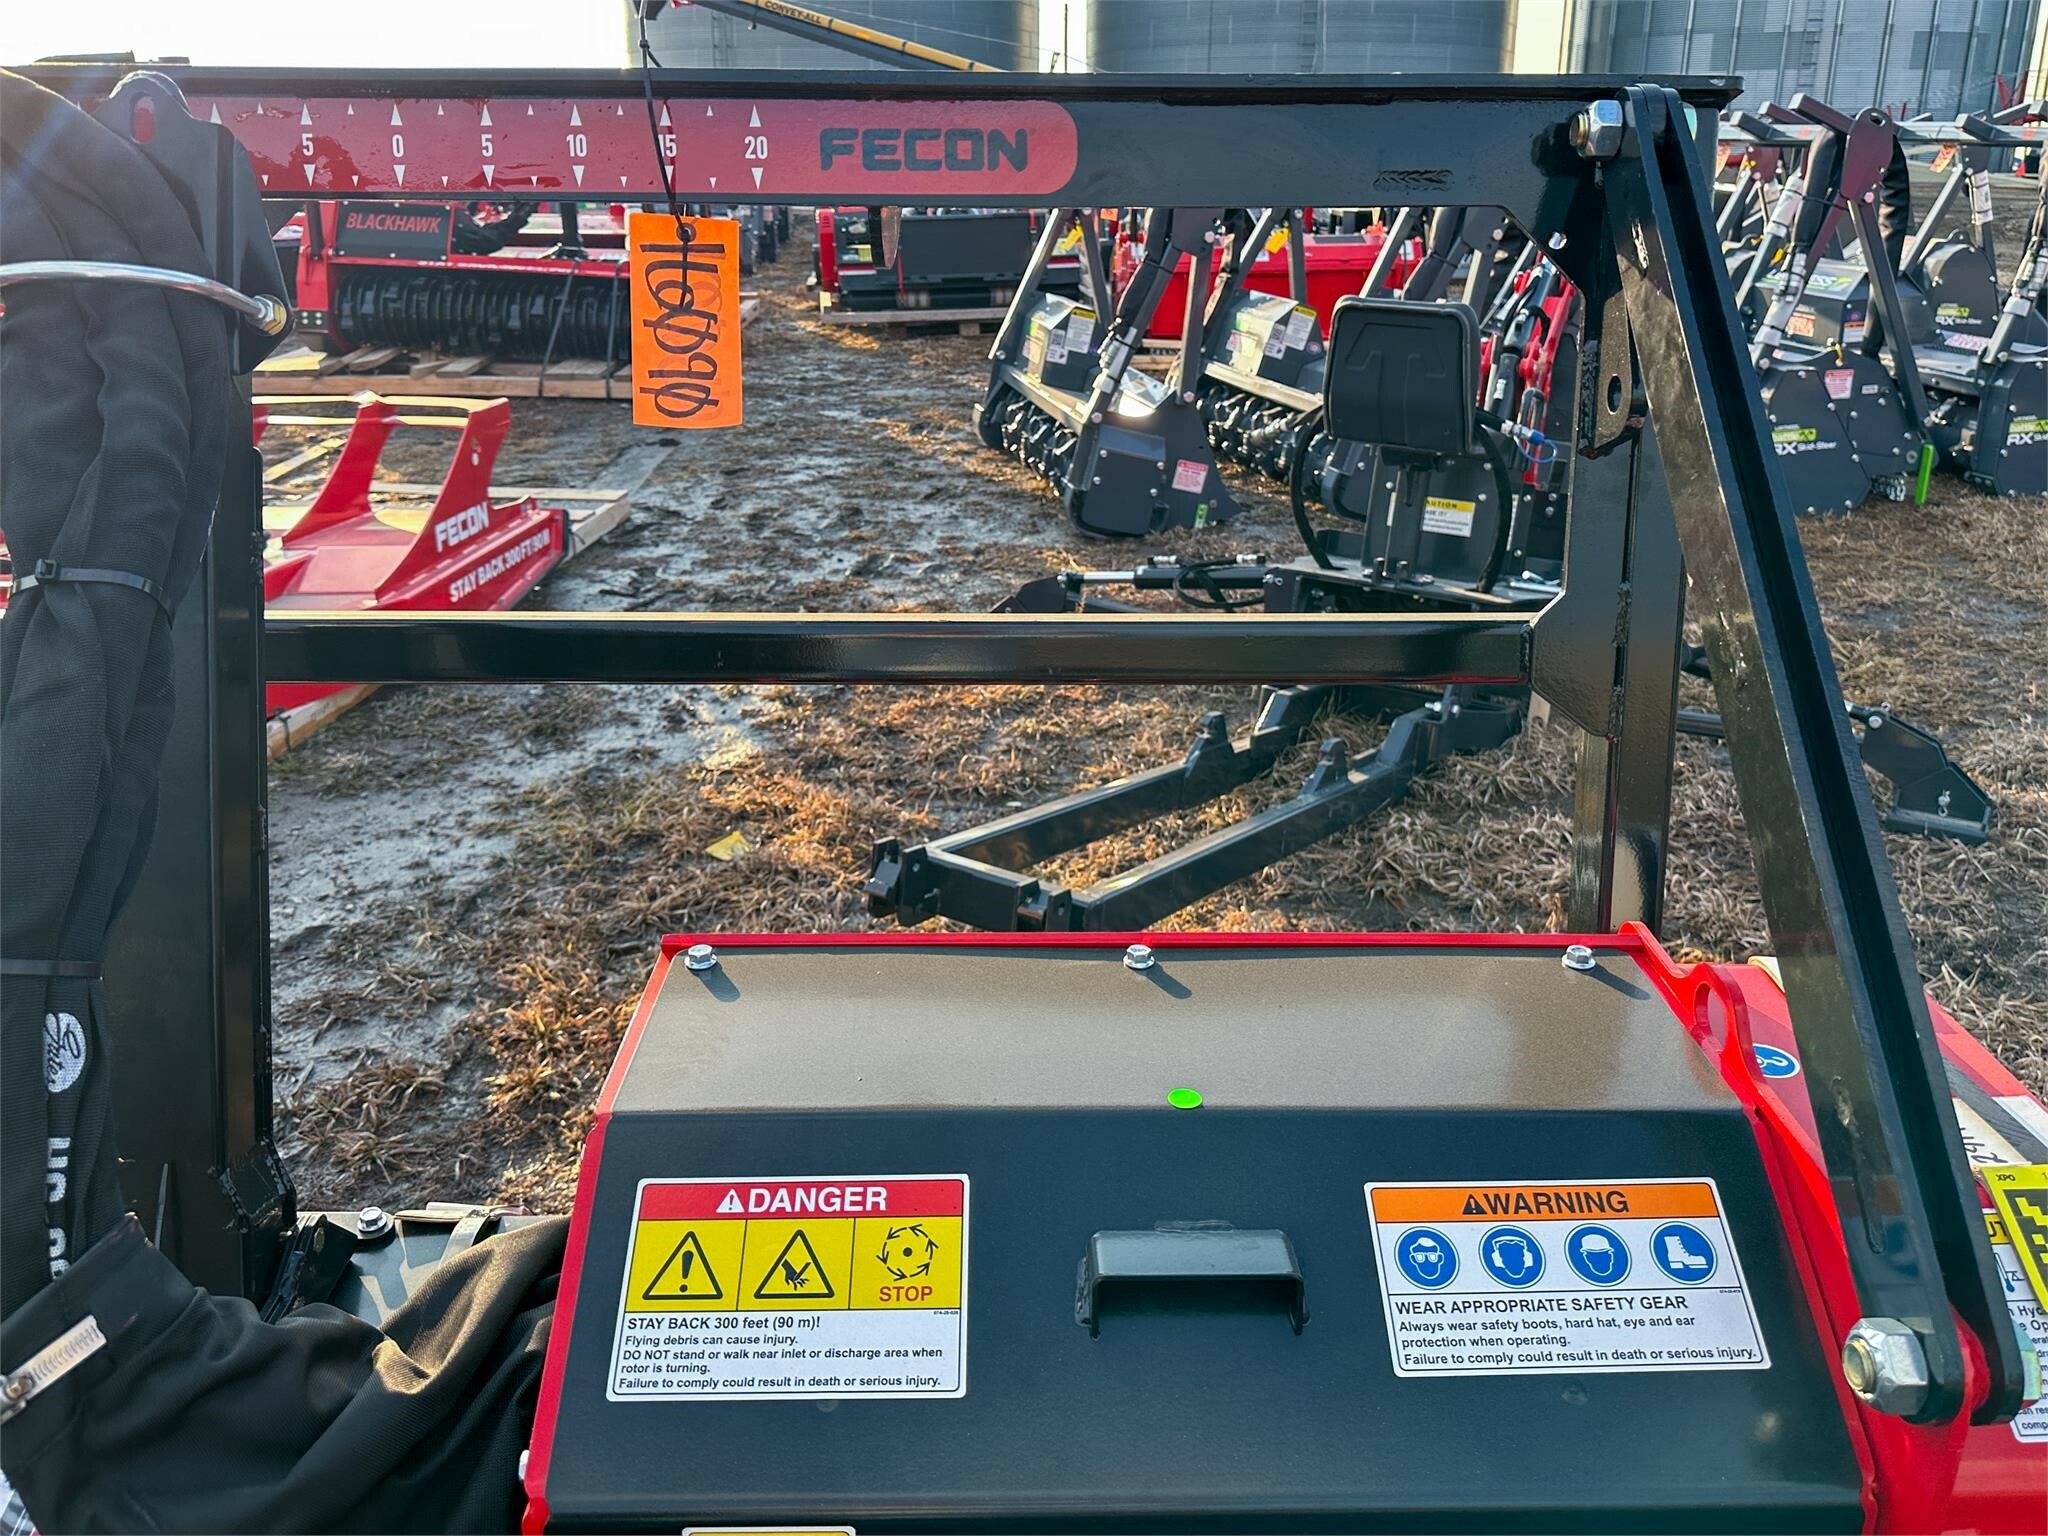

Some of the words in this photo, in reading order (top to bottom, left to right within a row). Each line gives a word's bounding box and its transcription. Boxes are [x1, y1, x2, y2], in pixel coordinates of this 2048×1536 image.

[301, 133, 314, 157] 5
[391, 134, 404, 158] 0
[482, 133, 494, 157] 5
[565, 134, 587, 158] 10
[658, 134, 677, 158] 15
[744, 135, 768, 160] 20
[819, 127, 1028, 173] FECON
[345, 212, 441, 233] BLACKHAWK
[435, 501, 490, 553] FECON
[449, 571, 477, 603] STAY
[477, 555, 506, 586] BACK
[1996, 1174, 2016, 1182] XPO
[748, 1186, 888, 1213] DANGER
[1483, 1190, 1630, 1215] WARNING
[879, 1286, 934, 1302] STOP
[1395, 1301, 1448, 1314] WEAR
[1451, 1299, 1568, 1314] APPROPRIATE
[1572, 1296, 1635, 1311] SAFETY
[1640, 1296, 1689, 1310] GEAR
[627, 1318, 665, 1330] STAY
[668, 1317, 711, 1330] BACK
[714, 1316, 739, 1329] 300
[742, 1316, 769, 1329] feet
[772, 1316, 794, 1332] (90
[797, 1316, 821, 1330] m)!
[1400, 1321, 1444, 1334] Always
[1447, 1322, 1478, 1330] wear
[1481, 1320, 1519, 1332] safety
[1522, 1318, 1562, 1330] boots,
[1565, 1318, 1594, 1328] hard
[1597, 1317, 1621, 1330] hat,
[1624, 1318, 1646, 1330] eye
[1649, 1316, 1671, 1327] and
[1676, 1316, 1696, 1326] ear
[625, 1336, 660, 1348] Flying
[663, 1335, 699, 1345] debris
[702, 1336, 723, 1345] can
[726, 1336, 760, 1345] cause
[763, 1334, 799, 1346] injury.
[1402, 1336, 1466, 1350] protection
[1469, 1336, 1504, 1346] when
[1507, 1335, 1571, 1347] operating.
[623, 1350, 642, 1360] DO
[644, 1350, 670, 1360] NOT
[673, 1350, 705, 1360] stand
[708, 1351, 721, 1360] or
[724, 1350, 750, 1359] walk
[752, 1350, 779, 1359] near
[781, 1349, 806, 1359] inlet
[809, 1350, 822, 1358] or
[824, 1348, 881, 1360] discharge
[884, 1349, 909, 1358] area
[912, 1348, 943, 1358] when
[1405, 1353, 1448, 1365] Failure
[1451, 1353, 1465, 1364] to
[1468, 1352, 1514, 1365] comply
[1517, 1351, 1553, 1362] could
[1556, 1350, 1593, 1362] result
[1595, 1349, 1608, 1360] in
[1611, 1349, 1647, 1360] death
[1650, 1350, 1664, 1359] or
[1667, 1348, 1714, 1358] serious
[1717, 1347, 1757, 1360] injury.
[621, 1364, 650, 1374] rotor
[653, 1363, 663, 1373] is
[666, 1363, 711, 1375] turning.
[619, 1378, 659, 1388] Failure
[662, 1378, 673, 1388] to
[677, 1377, 720, 1390] comply
[722, 1377, 755, 1387] could
[757, 1377, 791, 1387] result
[794, 1376, 805, 1386] in
[808, 1376, 841, 1386] death
[844, 1377, 857, 1386] or
[860, 1376, 902, 1386] serious
[905, 1376, 941, 1388] injury.
